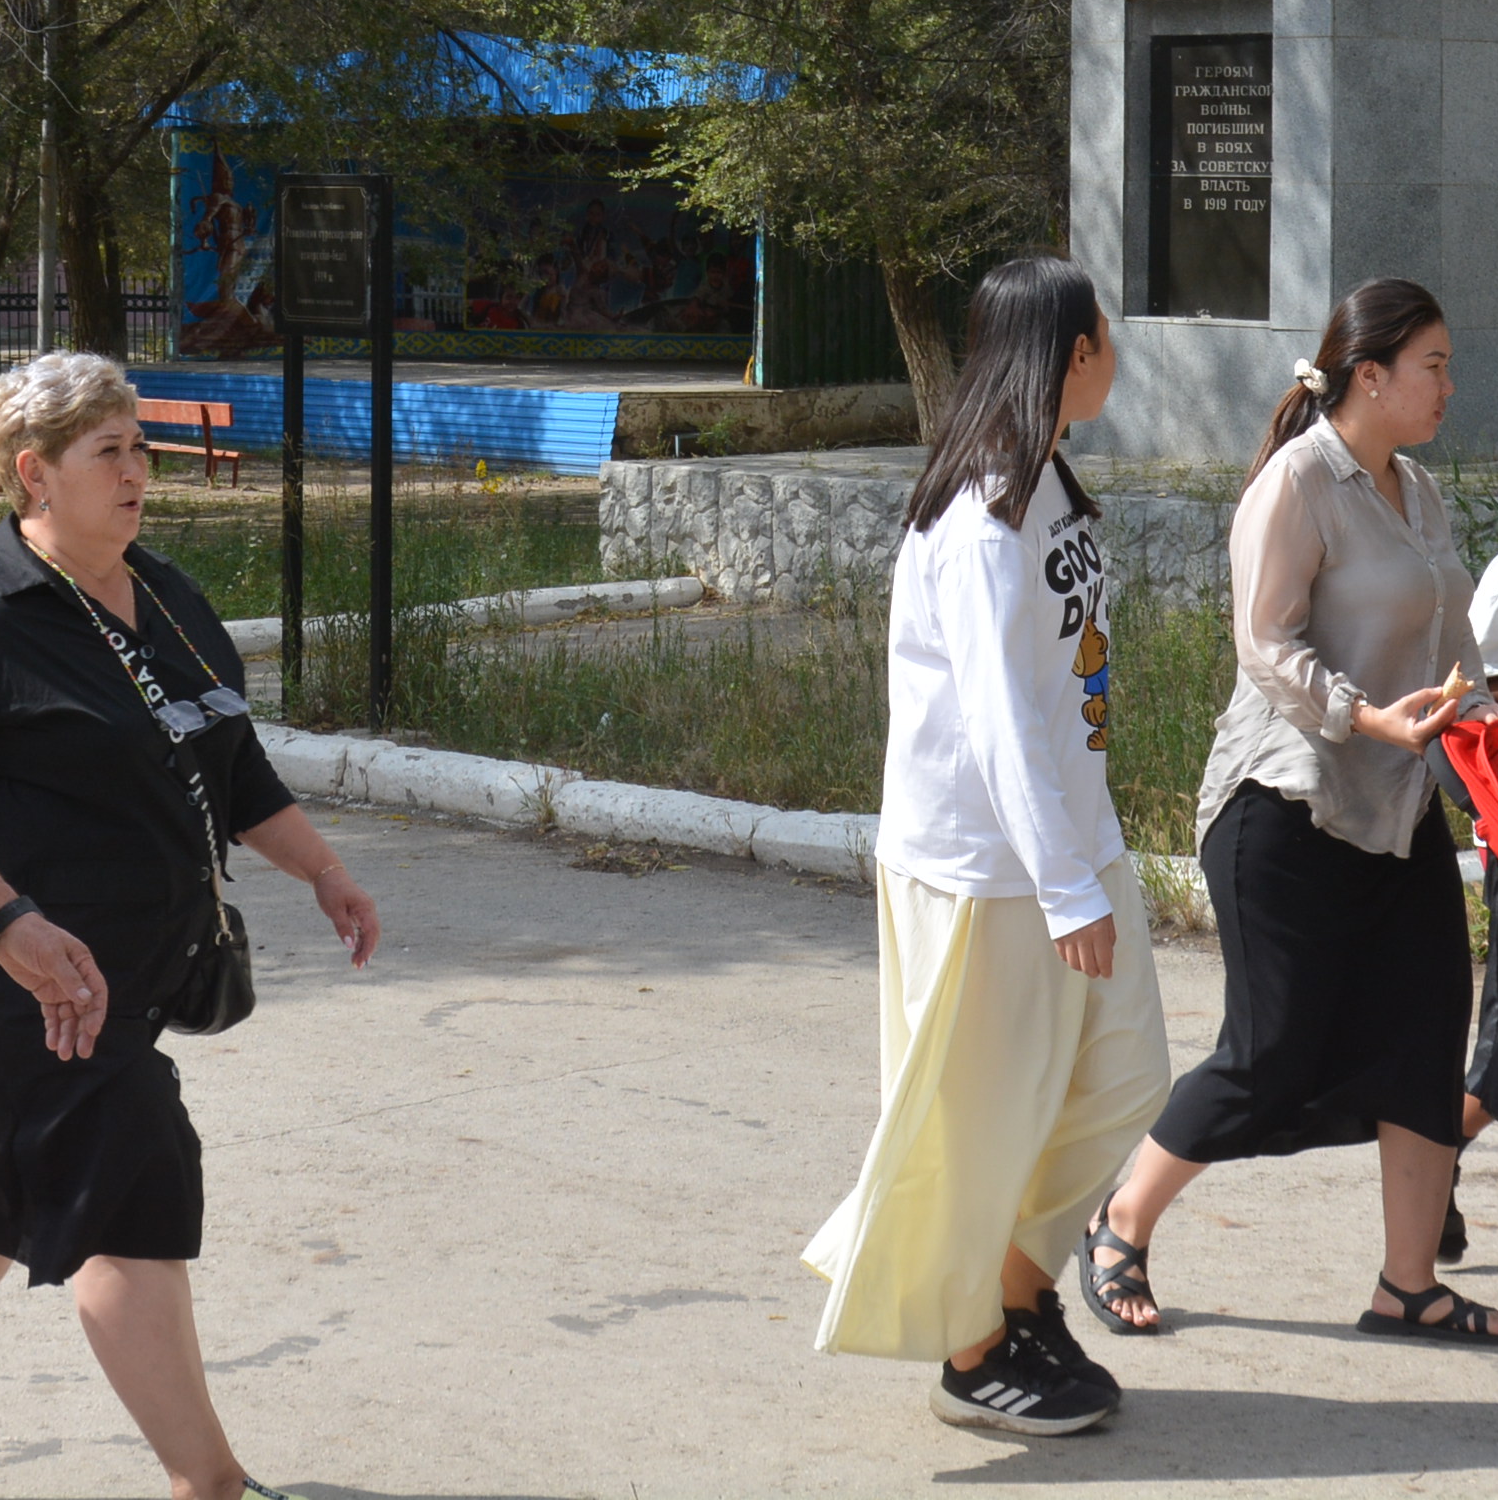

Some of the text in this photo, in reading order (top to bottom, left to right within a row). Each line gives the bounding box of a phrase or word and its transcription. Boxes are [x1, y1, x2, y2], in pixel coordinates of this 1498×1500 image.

[1195, 66, 1254, 78] ГЕРОЯМ
[1186, 123, 1264, 135] ПОГИБШИМ
[1197, 141, 1253, 153] В БОЯХ
[1170, 160, 1273, 173] ЗА СОВЕТСКУ
[1200, 179, 1251, 192] ВЛАСТЬ
[1183, 197, 1267, 213] В 1919 ГОДУ
